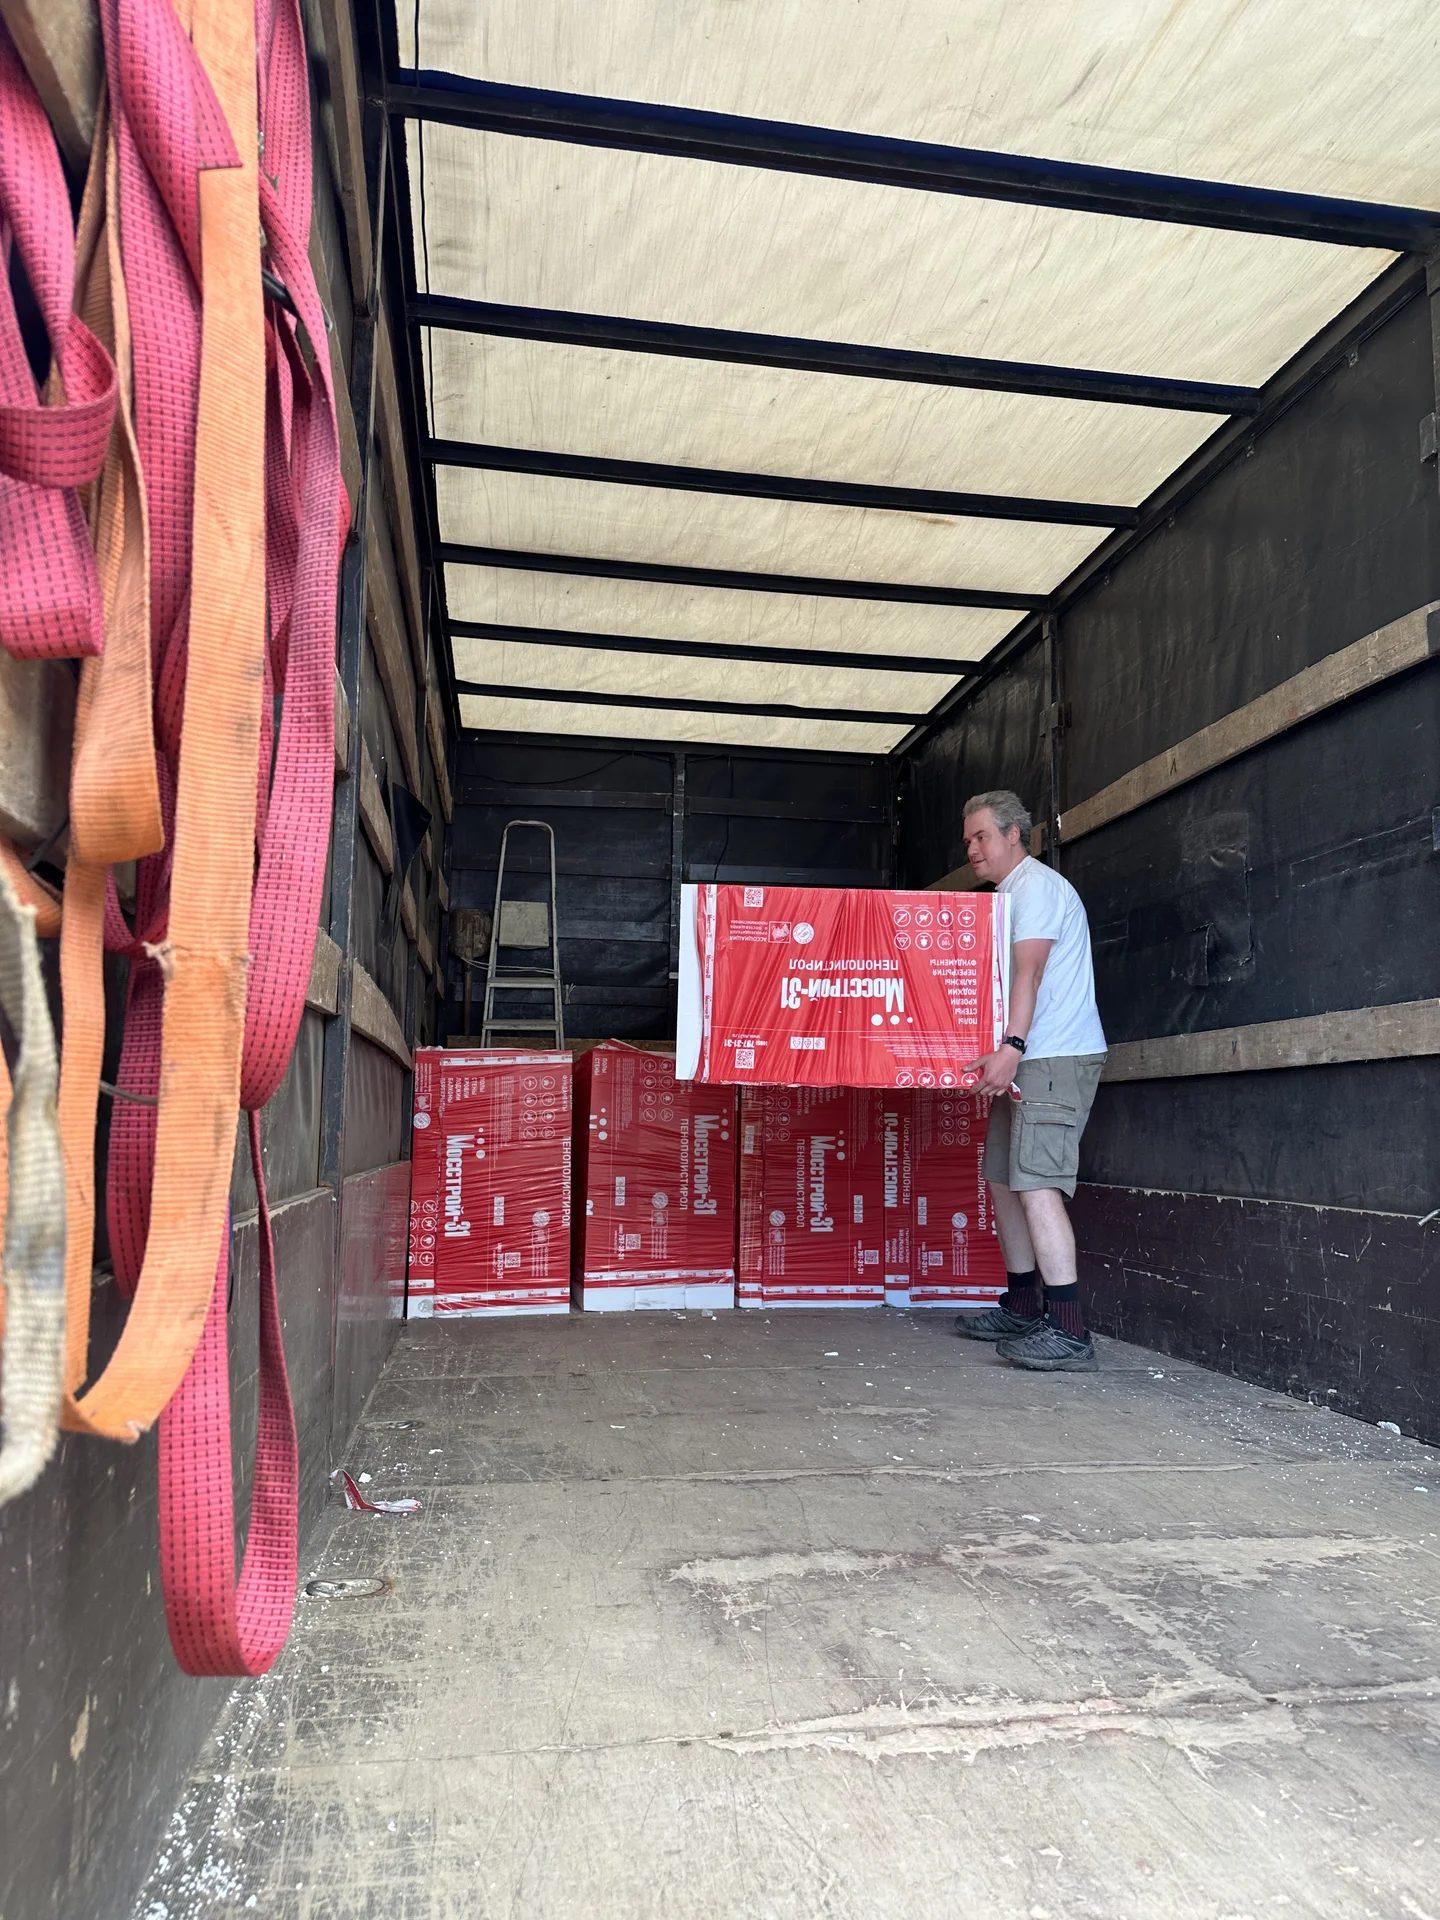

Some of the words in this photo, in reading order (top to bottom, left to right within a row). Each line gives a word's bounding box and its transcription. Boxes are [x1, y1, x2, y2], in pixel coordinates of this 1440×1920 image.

[789, 959, 899, 971] ПЕНОПОЛИСТИРОЛ
[944, 978, 977, 986] БАЛКОНЫ
[947, 987, 977, 995] ЛОДЖИИ
[724, 1039, 755, 1048] 797-31-31
[679, 1119, 689, 1210] ПЕНОПОЛИСТИРОЛ
[562, 1136, 571, 1226] ПЕНОПОЛИСТИРОЛ
[796, 1139, 805, 1228] ПЕНОПОЛИСТИРОЛ
